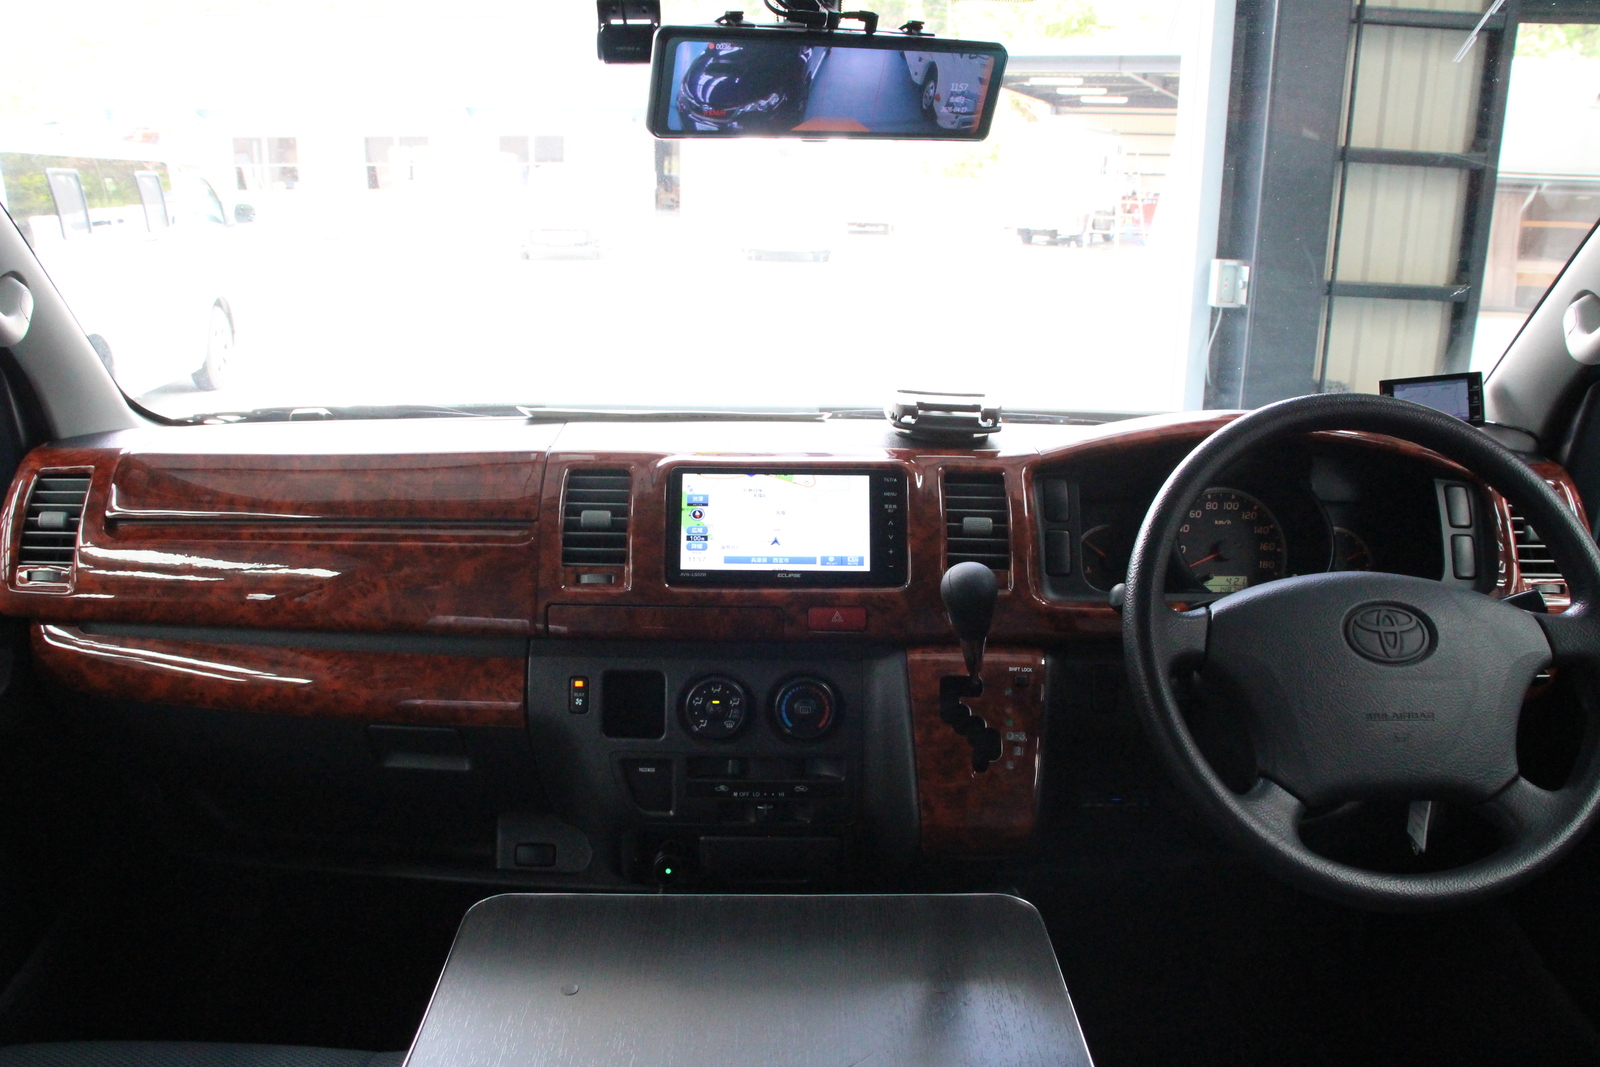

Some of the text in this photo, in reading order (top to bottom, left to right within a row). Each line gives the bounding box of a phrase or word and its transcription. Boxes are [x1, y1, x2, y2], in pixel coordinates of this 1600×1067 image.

[1205, 501, 1218, 510] 80
[1223, 501, 1239, 510] 100
[1189, 510, 1202, 518] 60
[1242, 511, 1257, 520] 120
[1254, 526, 1270, 534] 140
[1260, 542, 1276, 551] 160
[1259, 560, 1275, 569] 180
[1393, 711, 1435, 720] AIRBAG
